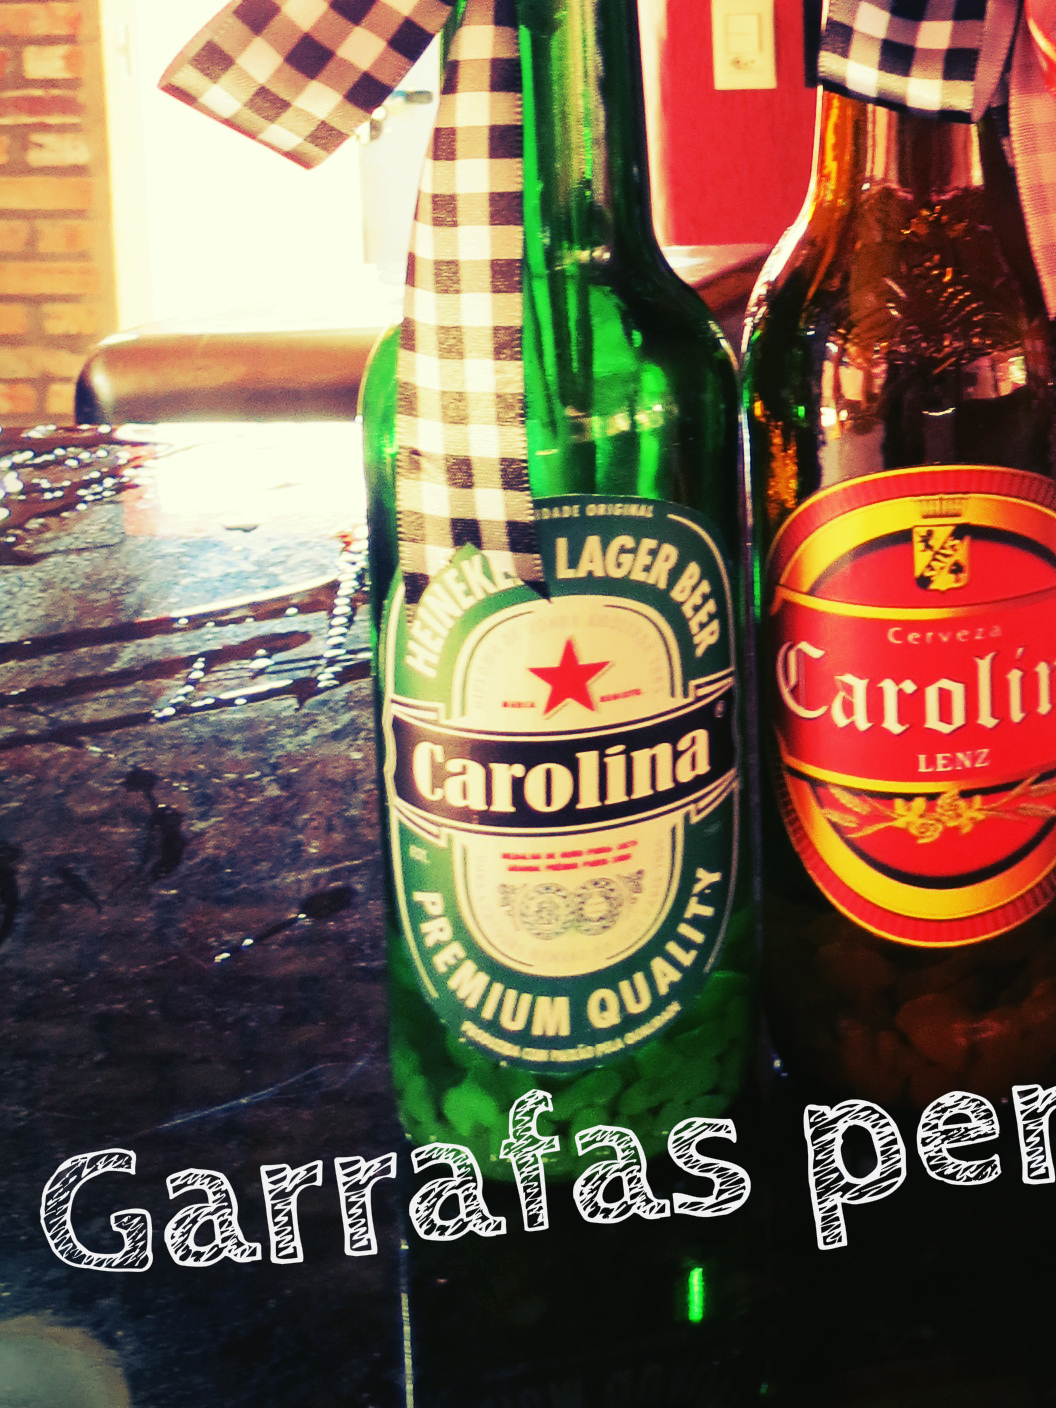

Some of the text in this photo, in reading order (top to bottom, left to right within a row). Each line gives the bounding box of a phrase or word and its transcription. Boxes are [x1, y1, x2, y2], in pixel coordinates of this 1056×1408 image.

[555, 534, 679, 590] LAGER
[669, 560, 721, 658] BEER
[886, 625, 1003, 645] Cerveza
[411, 726, 711, 814] Carolina
[917, 748, 991, 773] LENZ
[413, 890, 571, 1037] PREMIUM
[586, 867, 722, 1029] QUALITY
